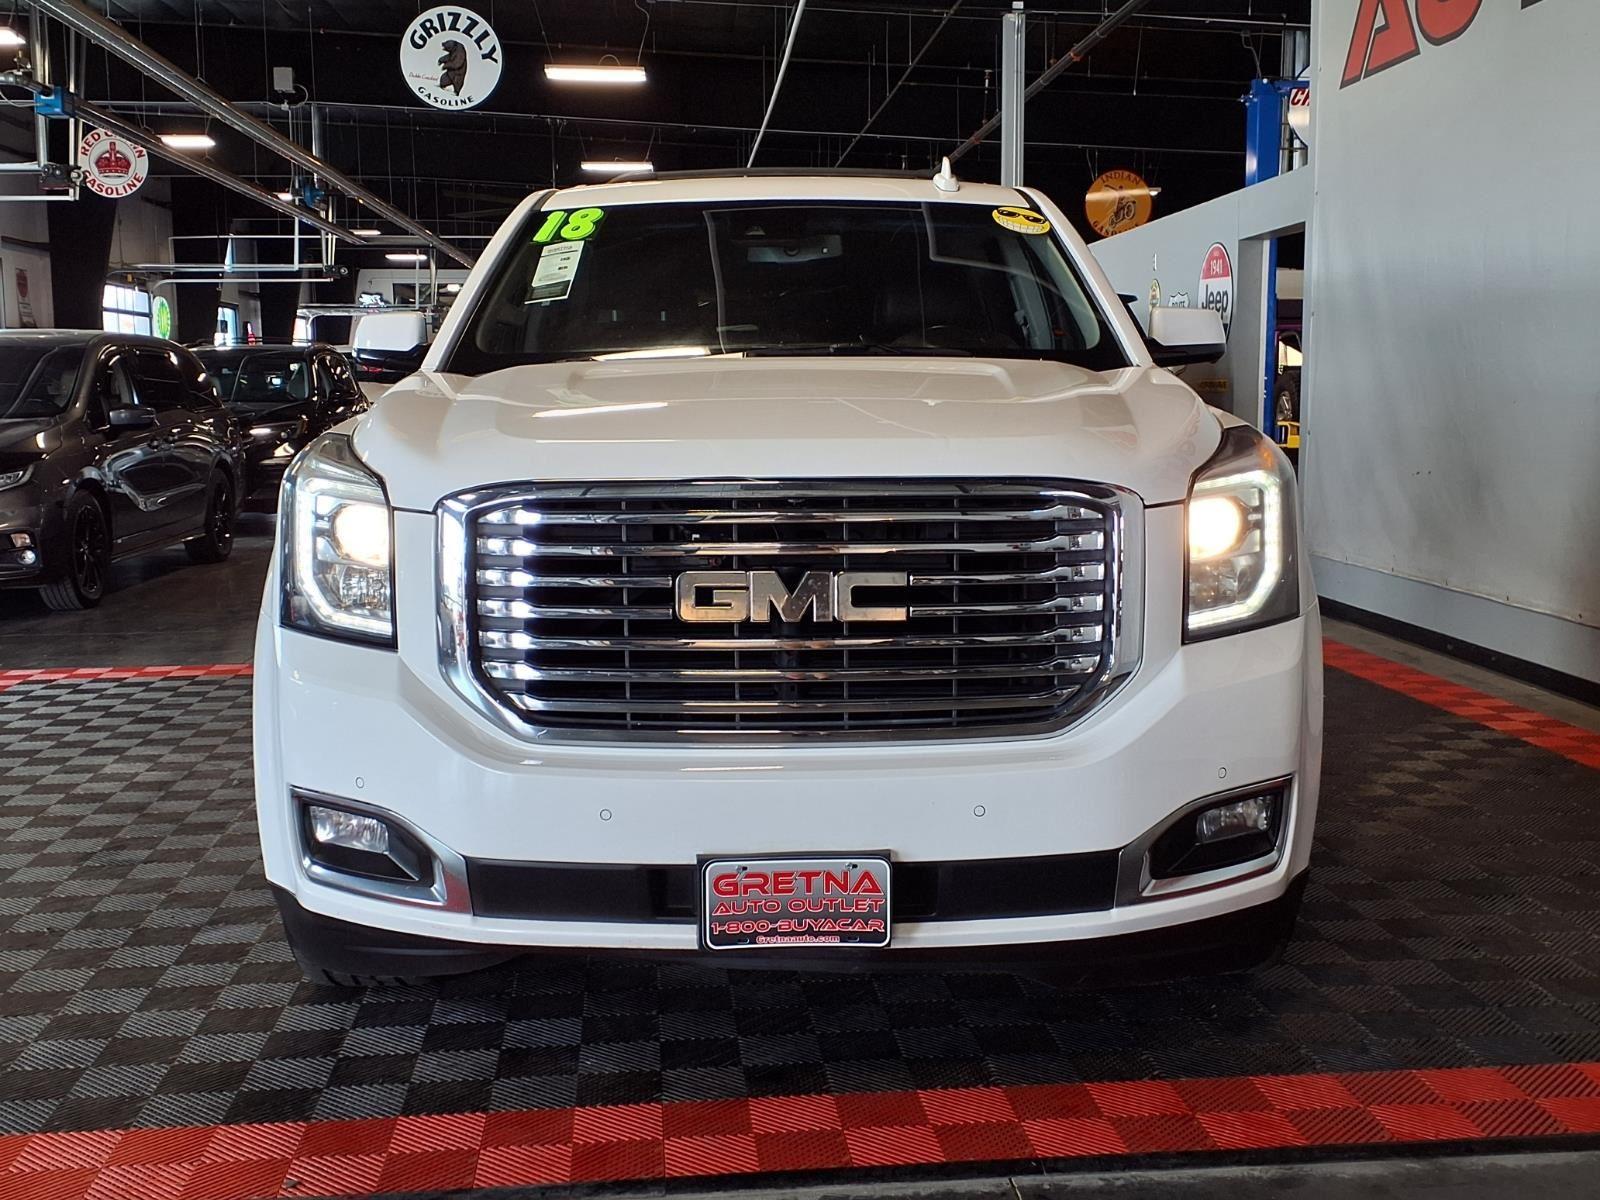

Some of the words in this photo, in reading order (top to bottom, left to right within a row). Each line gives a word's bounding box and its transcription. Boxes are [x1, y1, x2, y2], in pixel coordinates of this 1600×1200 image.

[409, 11, 499, 64] GRIZZLY
[418, 86, 475, 107] GASOLINE
[80, 131, 101, 157] RED
[1101, 171, 1141, 185] INDIAN
[532, 207, 605, 243] 18
[1210, 258, 1223, 276] 1941
[1201, 283, 1229, 321] Jeep
[675, 570, 908, 623] GMC
[712, 870, 885, 898] GRETNA
[711, 898, 782, 916] AUTO
[787, 897, 886, 913] OUTLET
[711, 917, 886, 935] 1-800-BUYACAR
